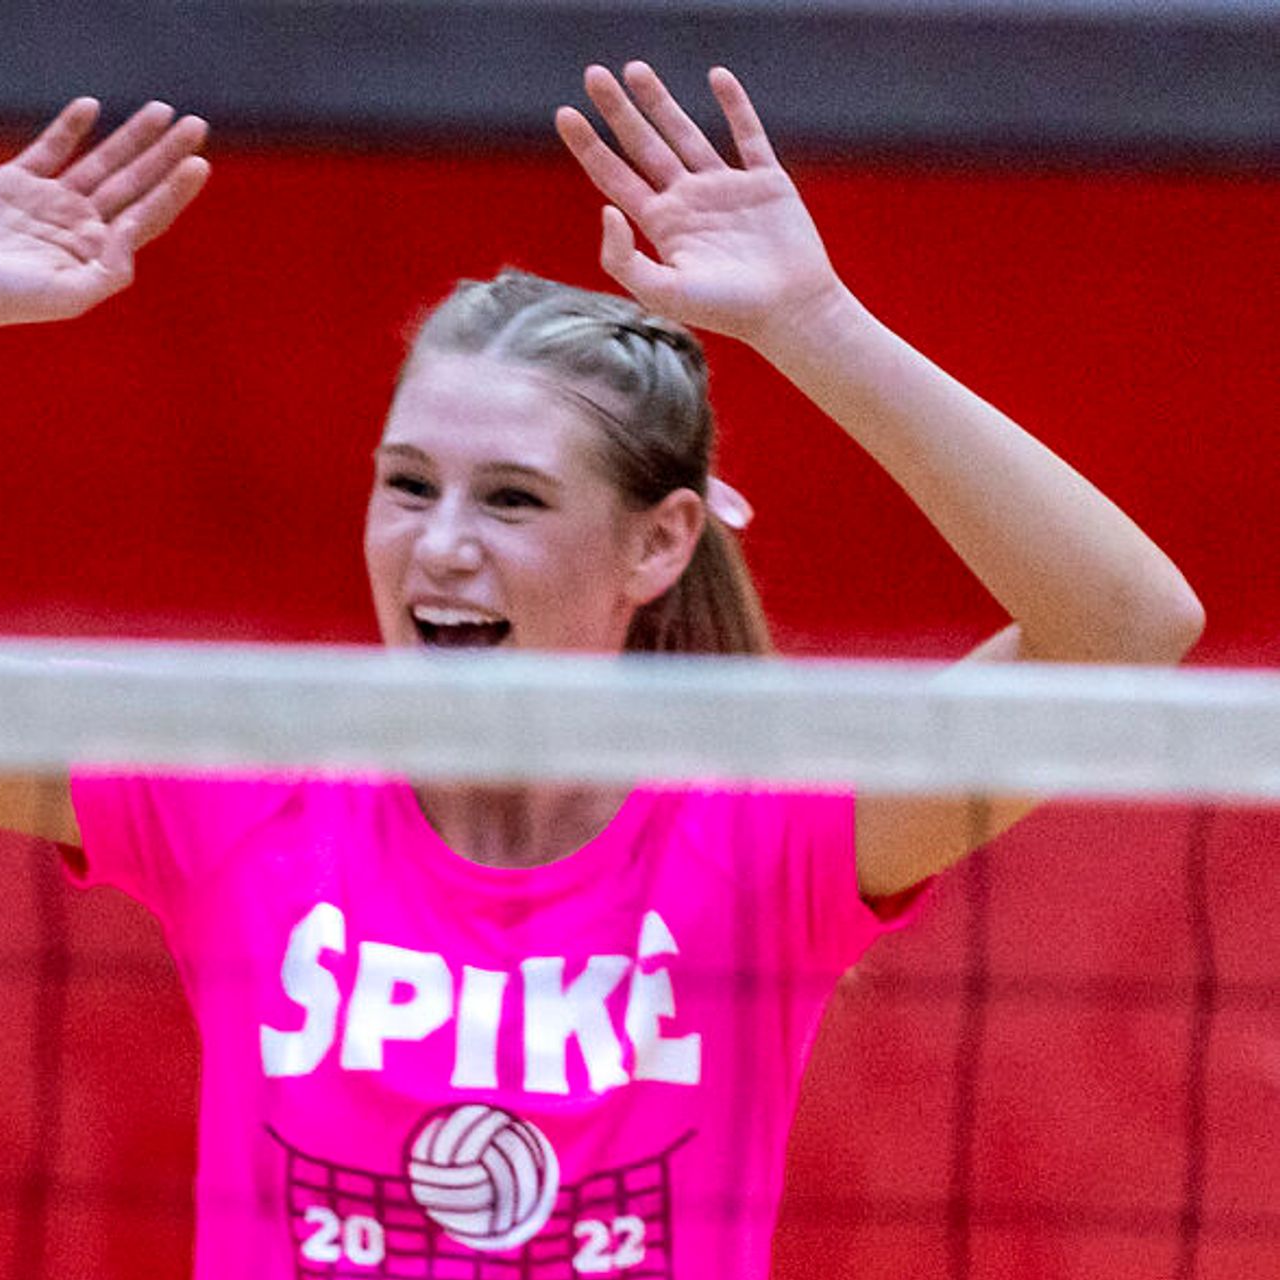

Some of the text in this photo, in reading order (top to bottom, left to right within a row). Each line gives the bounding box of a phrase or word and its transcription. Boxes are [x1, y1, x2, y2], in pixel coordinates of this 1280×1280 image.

[260, 901, 702, 1094] SPIKE
[300, 1206, 646, 1273] 20 22
